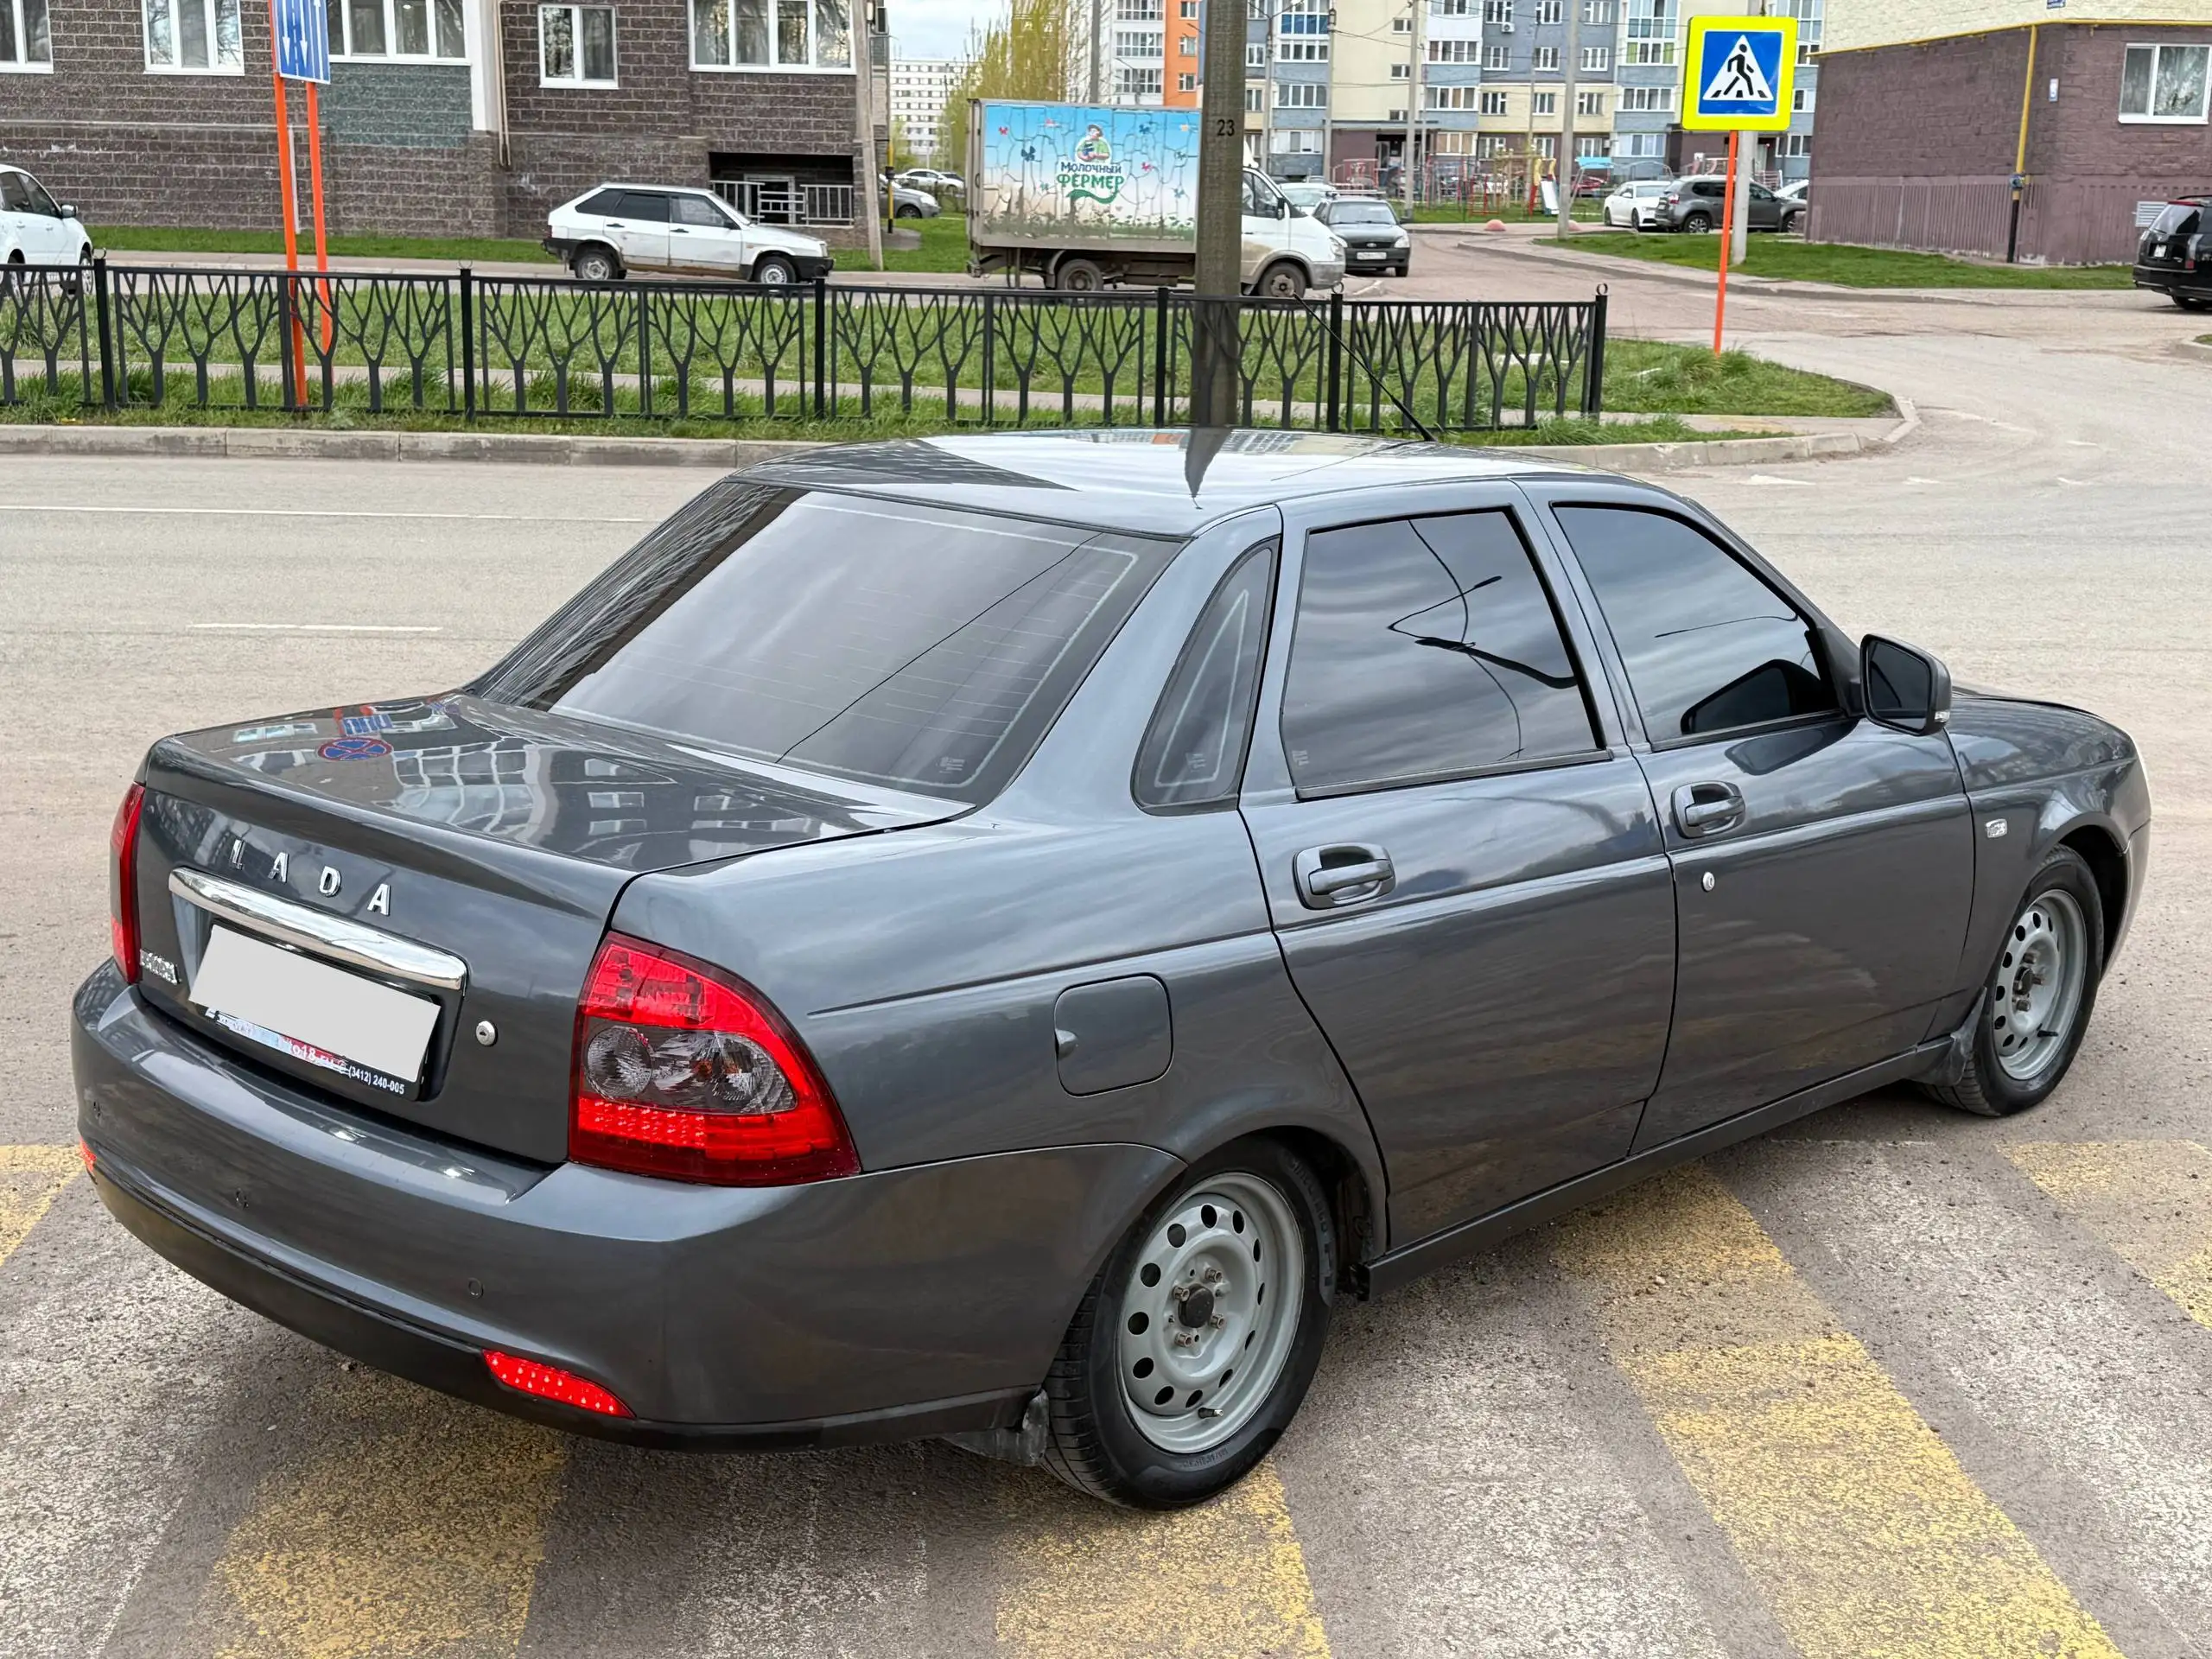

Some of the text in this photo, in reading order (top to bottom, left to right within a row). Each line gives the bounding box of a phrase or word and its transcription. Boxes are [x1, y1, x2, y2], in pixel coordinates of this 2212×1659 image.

[1217, 118, 1235, 137] 23
[1057, 173, 1125, 194] ФЕРМЕР
[230, 839, 391, 916] LADA
[348, 1065, 372, 1086] (3412)
[372, 1074, 405, 1095] 240-005
